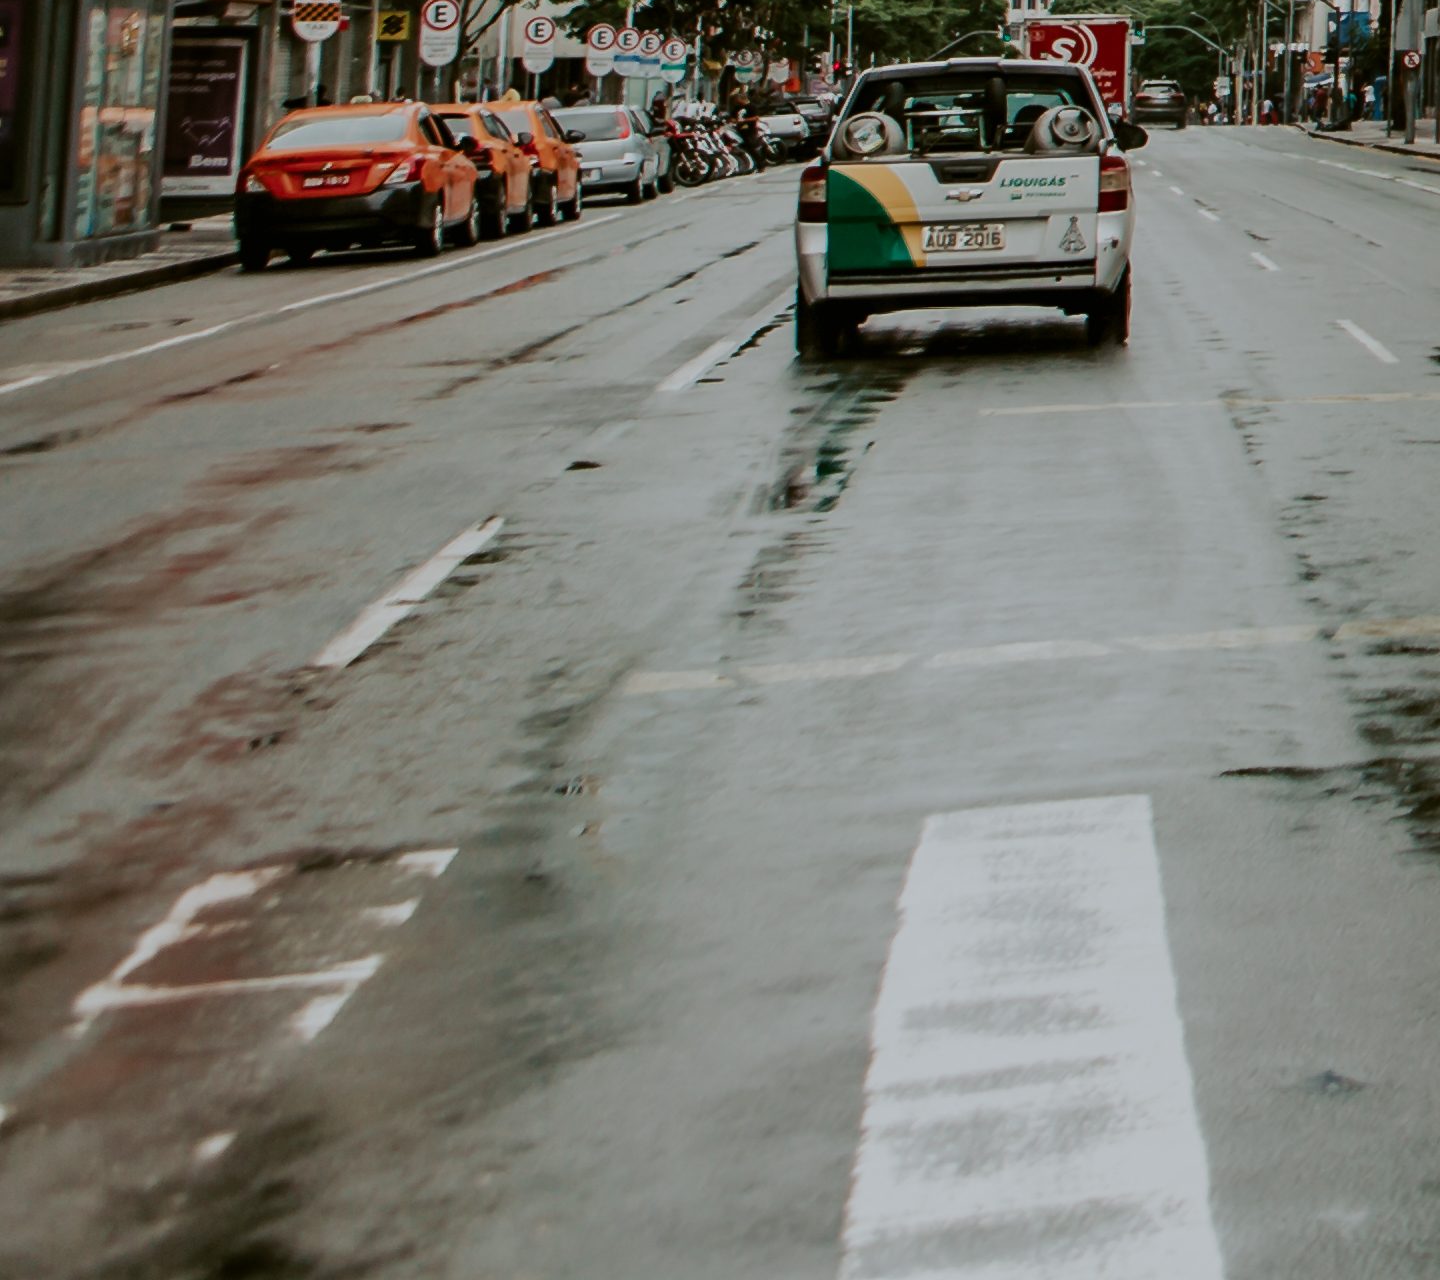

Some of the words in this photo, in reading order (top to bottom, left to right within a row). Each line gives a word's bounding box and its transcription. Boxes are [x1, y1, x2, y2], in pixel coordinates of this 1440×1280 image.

[434, 5, 447, 23] E
[534, 22, 545, 38] E
[597, 30, 607, 44] E
[623, 32, 633, 46] E
[645, 36, 654, 50] E
[671, 44, 679, 55] E
[999, 175, 1067, 188] LIQUIGÁS
